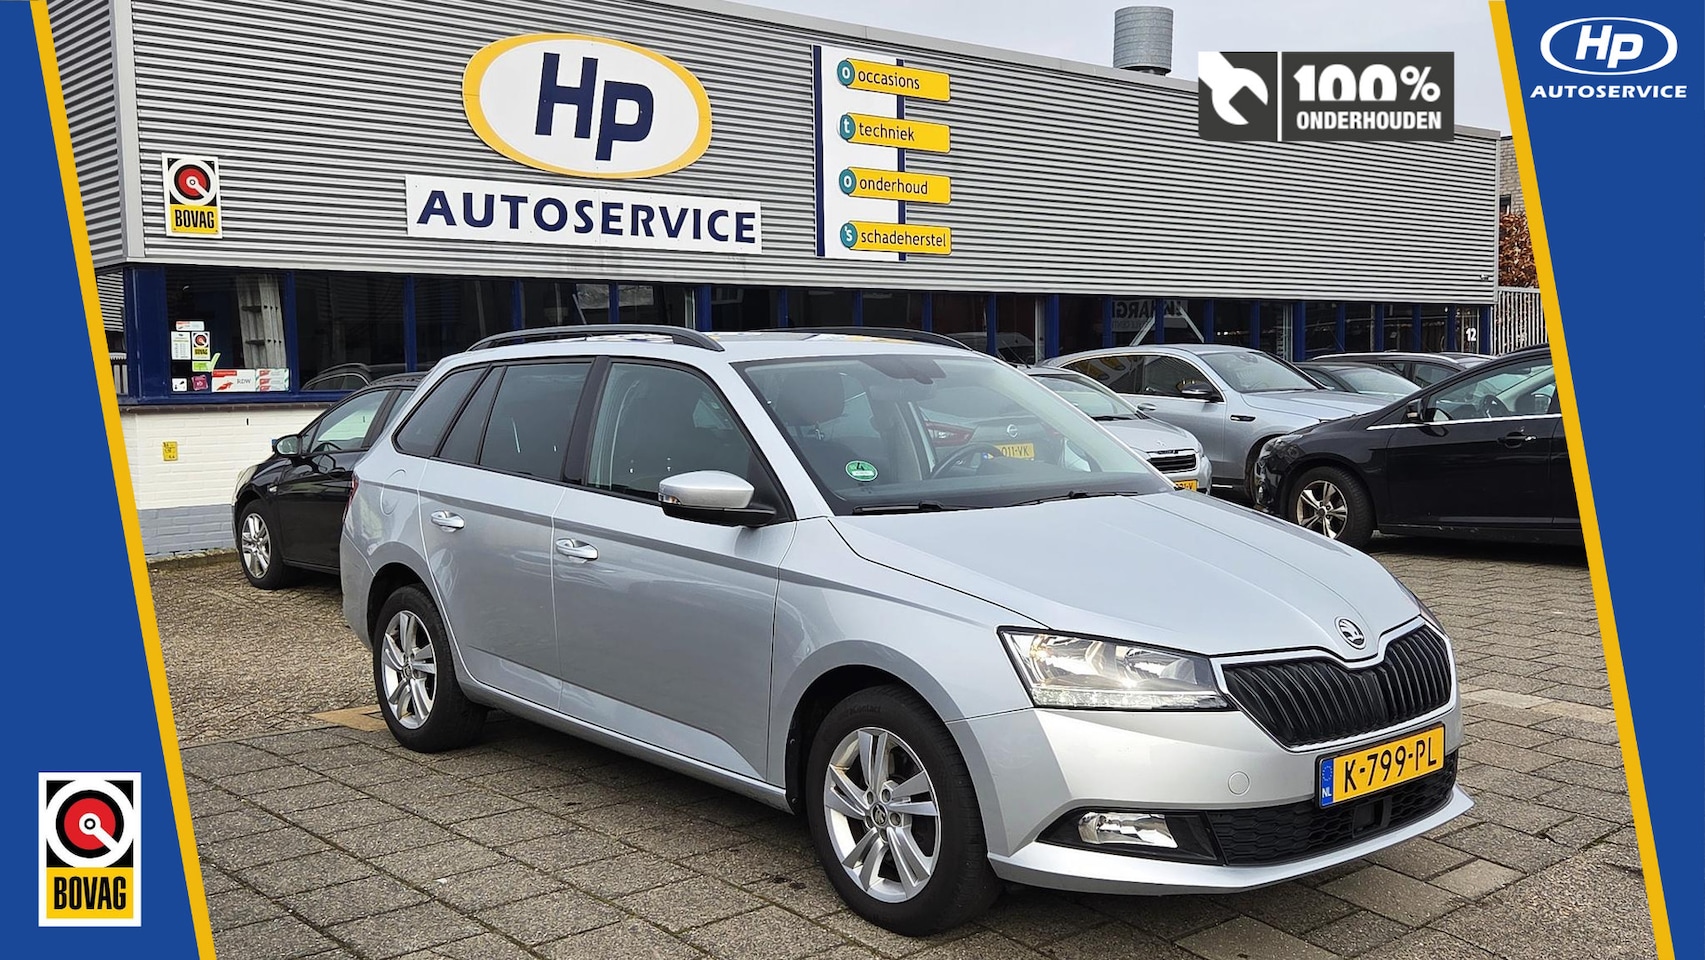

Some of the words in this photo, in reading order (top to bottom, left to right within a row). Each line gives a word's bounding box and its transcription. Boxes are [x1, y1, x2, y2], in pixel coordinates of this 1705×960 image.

[858, 69, 920, 90] occasions
[859, 122, 915, 142] techniek
[859, 176, 928, 195] onderhoud
[174, 209, 215, 229] BOVAG
[417, 190, 756, 244] AUTOSERVICE
[861, 228, 946, 247] schadeherstel
[1465, 327, 1477, 342] 12
[1344, 737, 1437, 793] K-799-PL
[1322, 786, 1332, 798] NL
